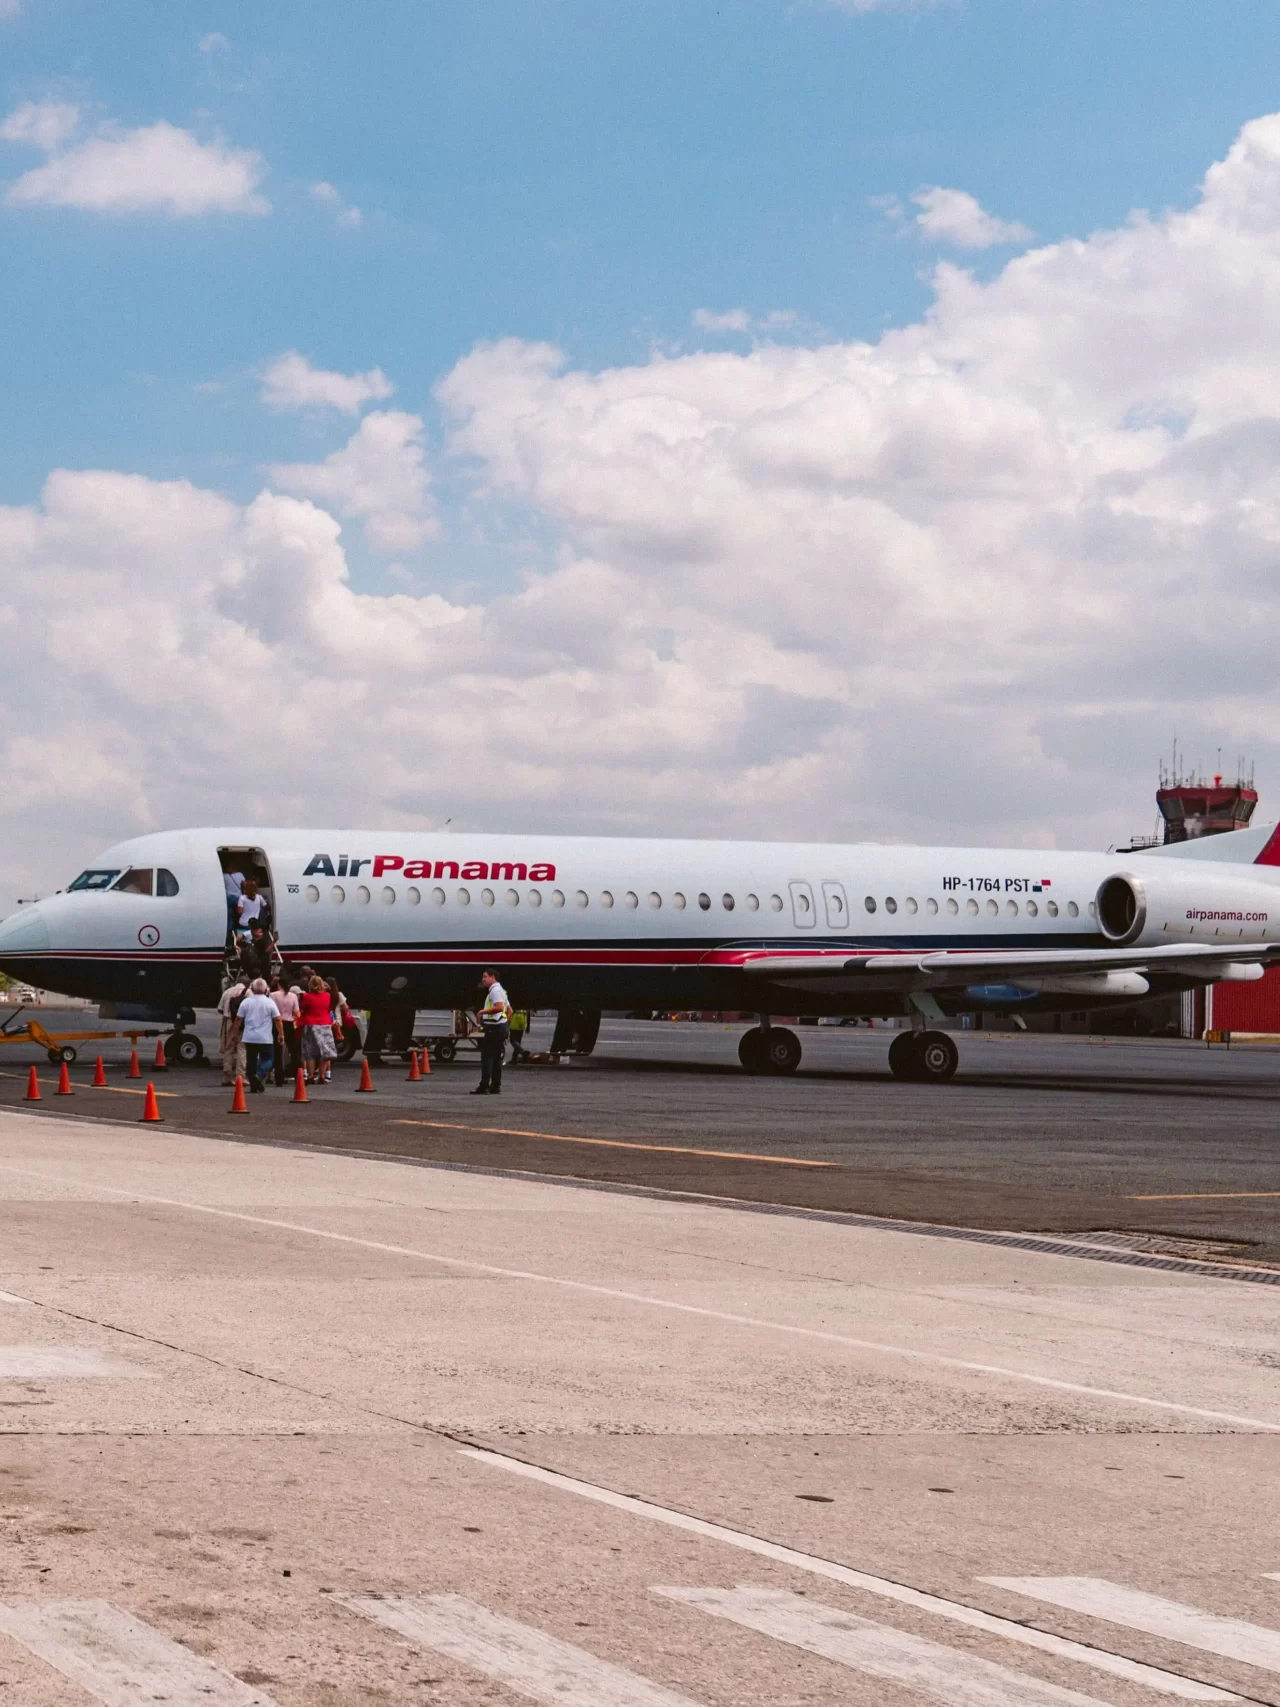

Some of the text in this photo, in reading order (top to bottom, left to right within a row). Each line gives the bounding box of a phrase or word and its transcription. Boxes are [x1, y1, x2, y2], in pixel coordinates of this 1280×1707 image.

[943, 877, 1030, 892] HP-1764 PST
[1186, 908, 1268, 922] airpanama.com
